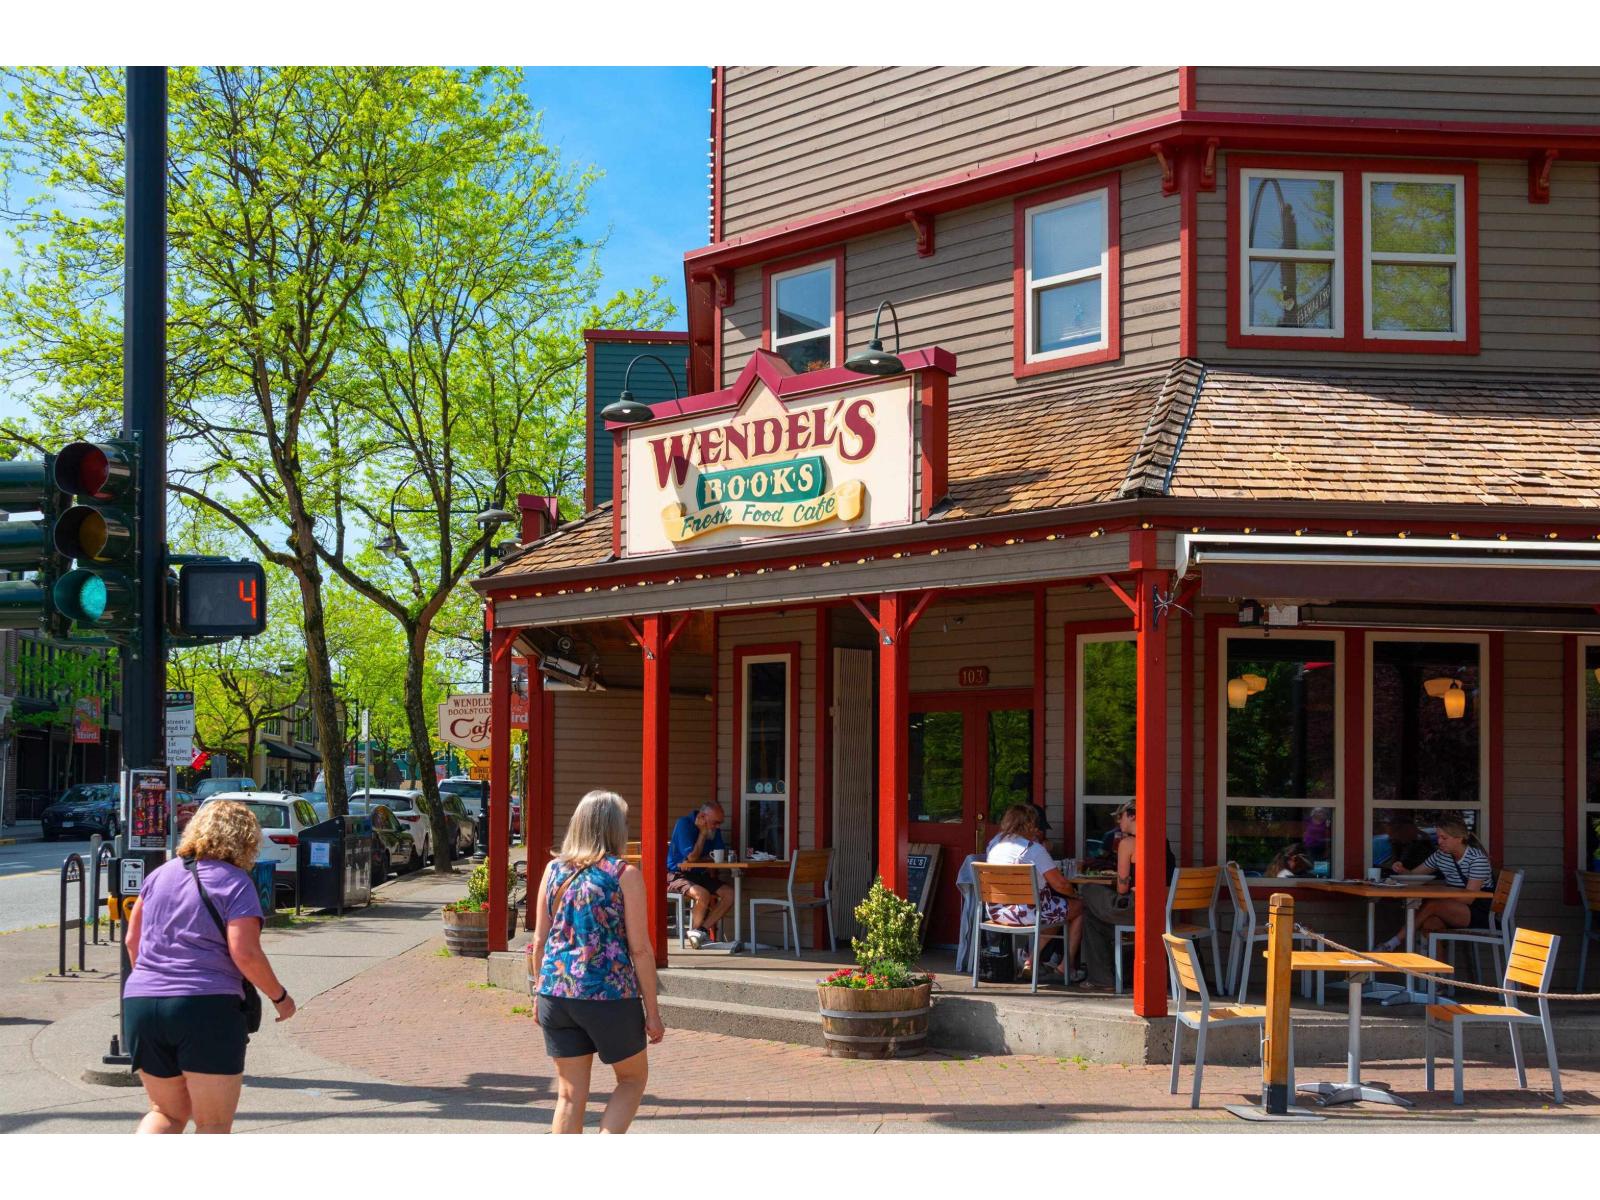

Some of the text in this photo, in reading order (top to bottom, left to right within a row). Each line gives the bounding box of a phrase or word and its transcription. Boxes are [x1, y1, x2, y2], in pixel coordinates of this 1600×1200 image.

[648, 399, 876, 489] WENDEL'S
[703, 463, 814, 504] BOOKS
[681, 505, 732, 537] Fresh
[742, 504, 784, 523] Food
[239, 579, 257, 619] 4
[963, 669, 984, 684] 103
[450, 715, 492, 742] Caf
